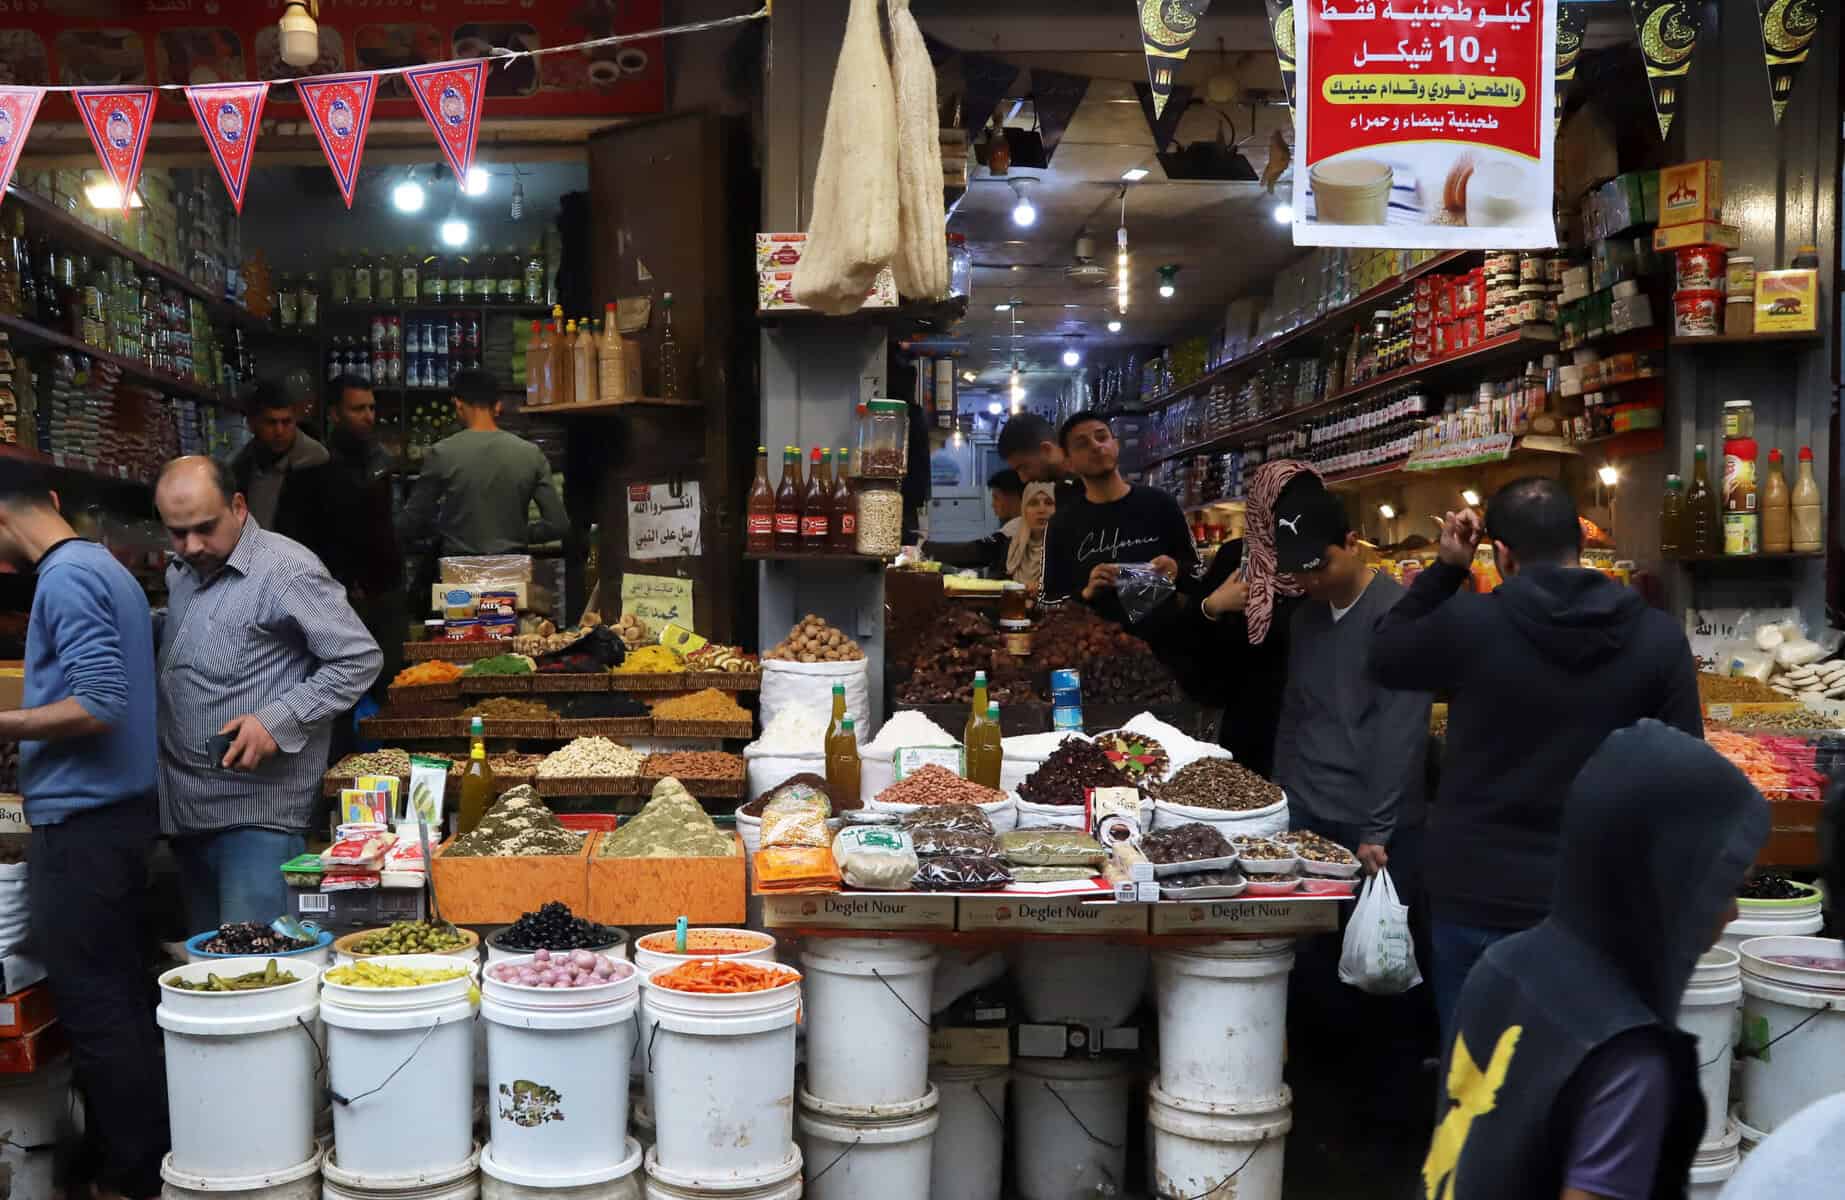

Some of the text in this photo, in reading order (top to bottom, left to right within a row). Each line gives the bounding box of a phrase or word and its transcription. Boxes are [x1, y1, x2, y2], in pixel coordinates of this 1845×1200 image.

[1382, 0, 1471, 28] طحينية
[1477, 0, 1531, 30] كيلو
[1353, 36, 1433, 69] شيكل
[1439, 36, 1480, 63] 10
[1328, 78, 1521, 102] والطحن فوري وقدام عينيك
[1350, 111, 1499, 132] طحينية بيضاء وحمراء
[1077, 527, 1159, 561] California
[824, 900, 868, 916] Deglet
[872, 900, 907, 913] Nour
[1018, 904, 1062, 921] Deglet
[1066, 905, 1101, 919] Nour
[1211, 903, 1291, 920] Deglet Nour
